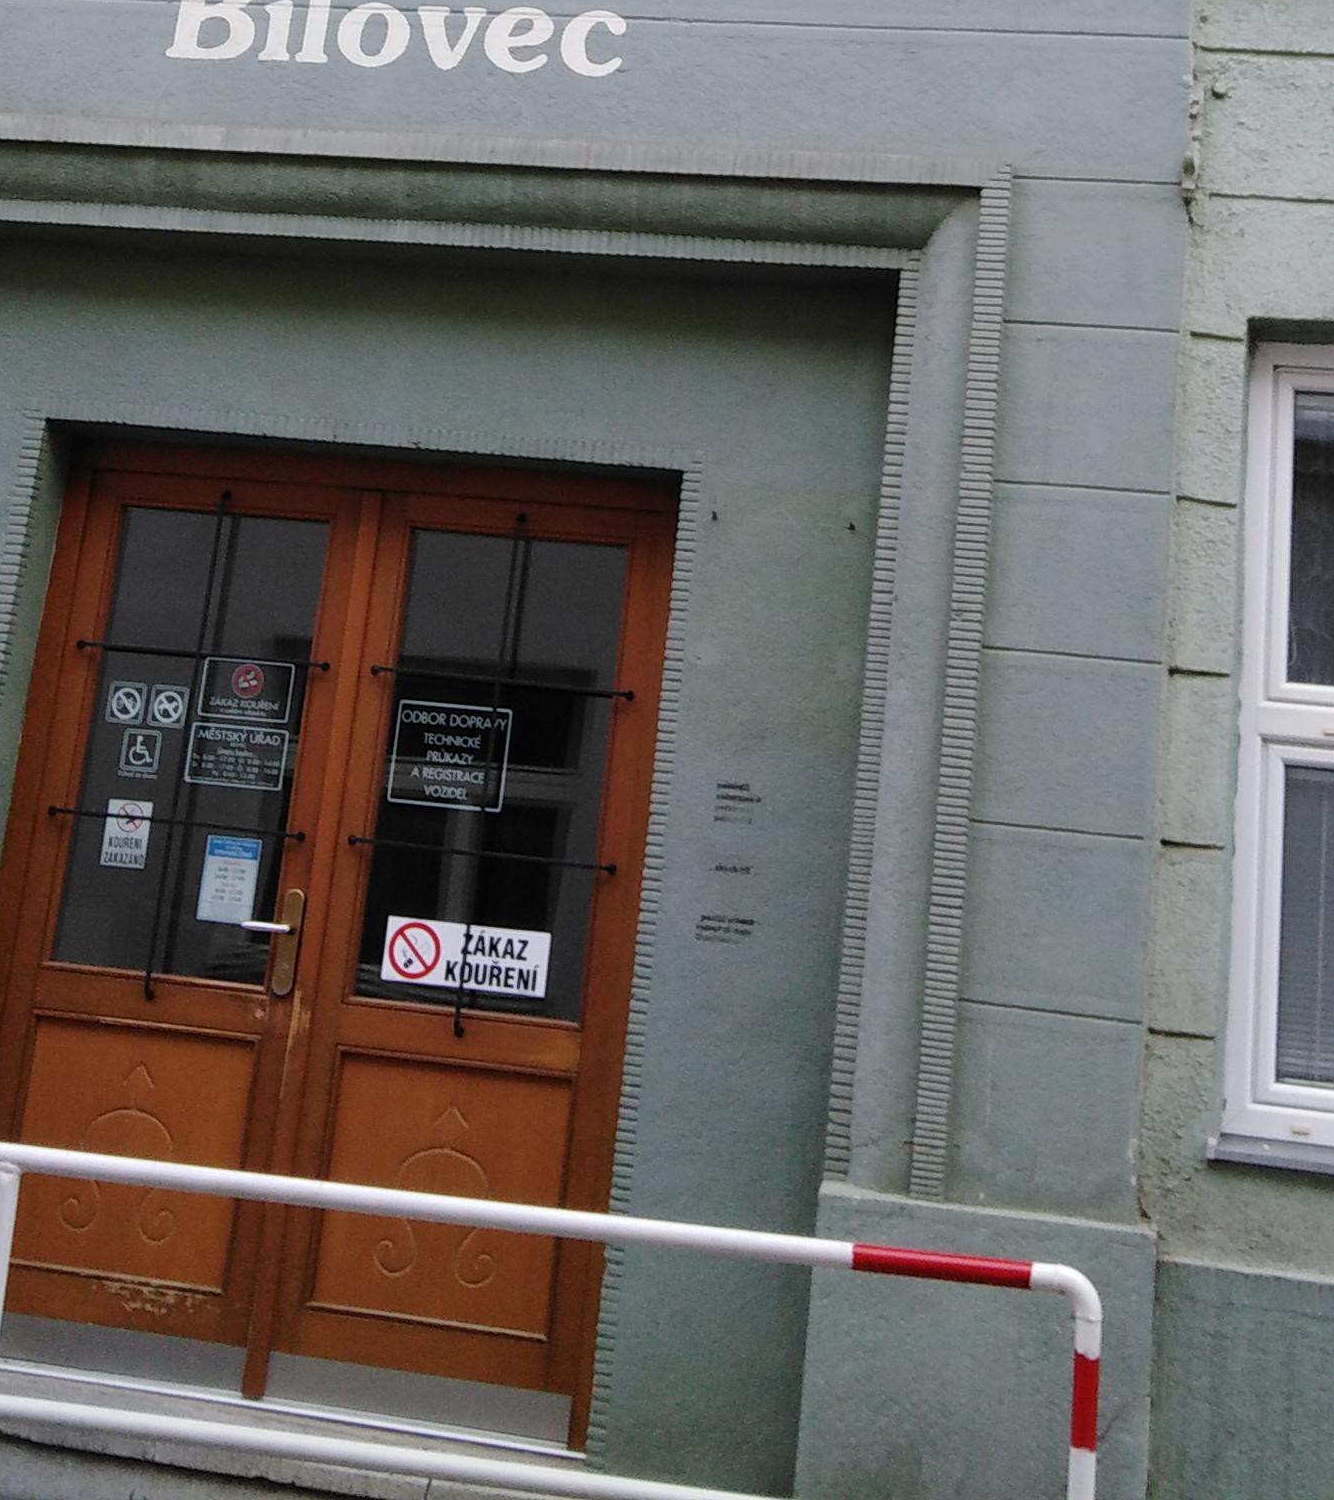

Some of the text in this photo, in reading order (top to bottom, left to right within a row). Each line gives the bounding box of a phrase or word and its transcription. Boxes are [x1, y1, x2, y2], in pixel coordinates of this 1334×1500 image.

[401, 709, 447, 726] ODBOR
[198, 727, 248, 742] MĚSTSKÝ
[423, 732, 482, 749] TECHNICKÉ
[426, 748, 474, 765] PRŮKAZY
[410, 765, 485, 784] A REGISTRACE
[423, 784, 467, 800] VOZIDEL
[461, 930, 529, 961] ZÁKAZ
[444, 960, 540, 991] KOUŘENÍ
